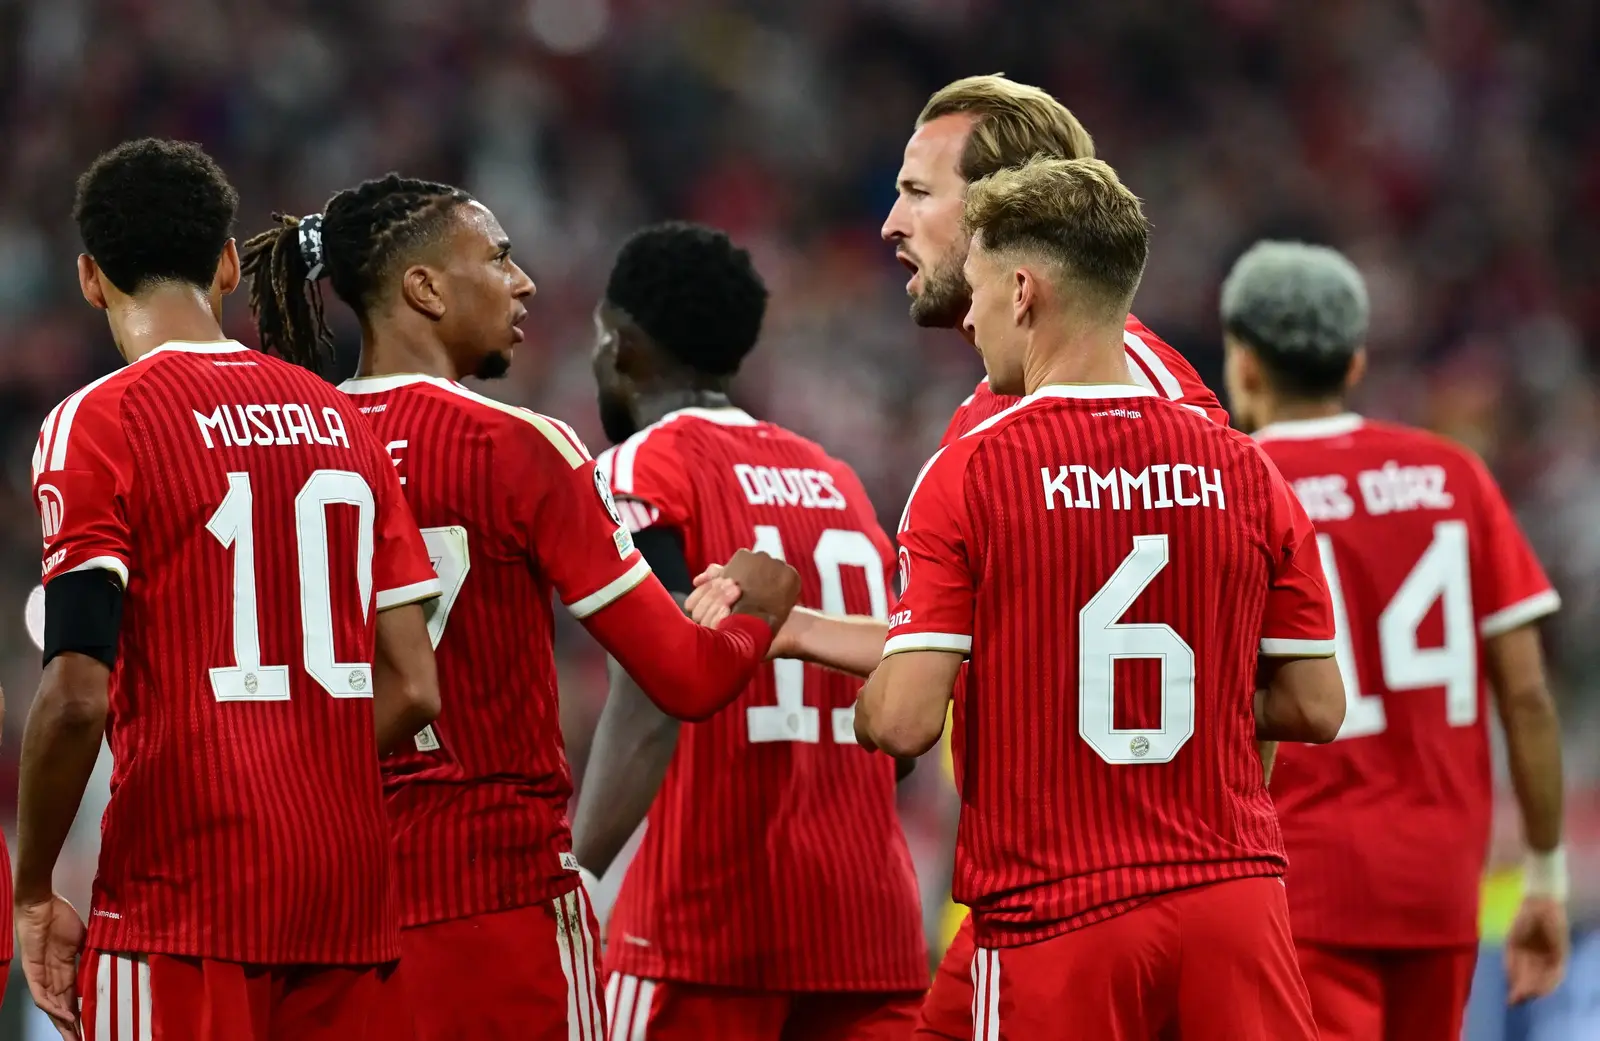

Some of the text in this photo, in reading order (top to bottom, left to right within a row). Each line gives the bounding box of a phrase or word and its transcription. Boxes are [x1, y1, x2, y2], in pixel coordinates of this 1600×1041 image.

[193, 403, 350, 448] MUSIALA
[1109, 409, 1126, 418] SAN
[1127, 410, 1142, 419] MIA
[734, 464, 846, 511] DAVIES
[1041, 464, 1226, 510] KIMMICH
[205, 469, 375, 702] 10
[1079, 534, 1195, 765] 6
